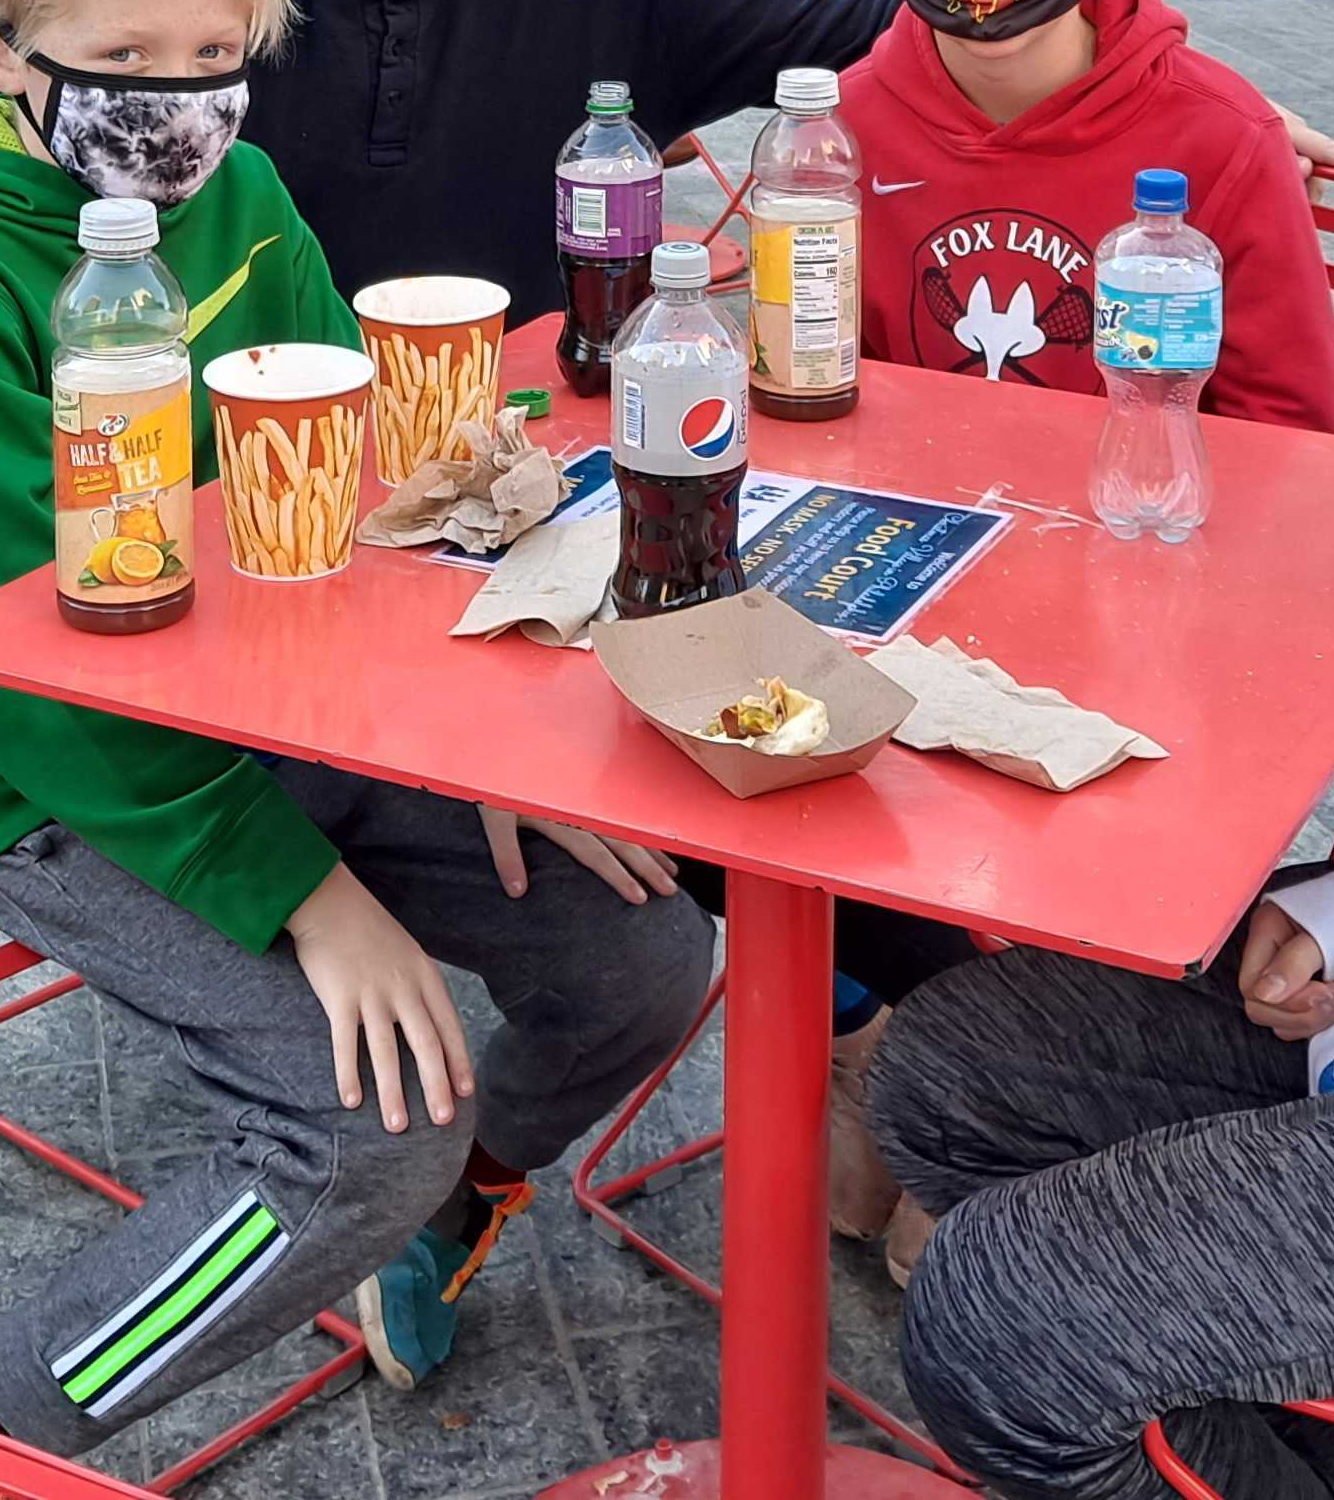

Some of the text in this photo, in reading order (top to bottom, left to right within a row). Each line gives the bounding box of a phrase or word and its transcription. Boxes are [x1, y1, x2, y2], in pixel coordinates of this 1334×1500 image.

[930, 221, 1089, 284] FOX LANE
[70, 429, 162, 467] HALF & HALF
[120, 456, 162, 489] TEA
[807, 493, 836, 508] NO
[775, 507, 821, 536] MASK
[919, 512, 968, 544] Christmas
[754, 537, 784, 555] NO
[803, 516, 917, 602] Food Court
[905, 551, 956, 591] Welcome to
